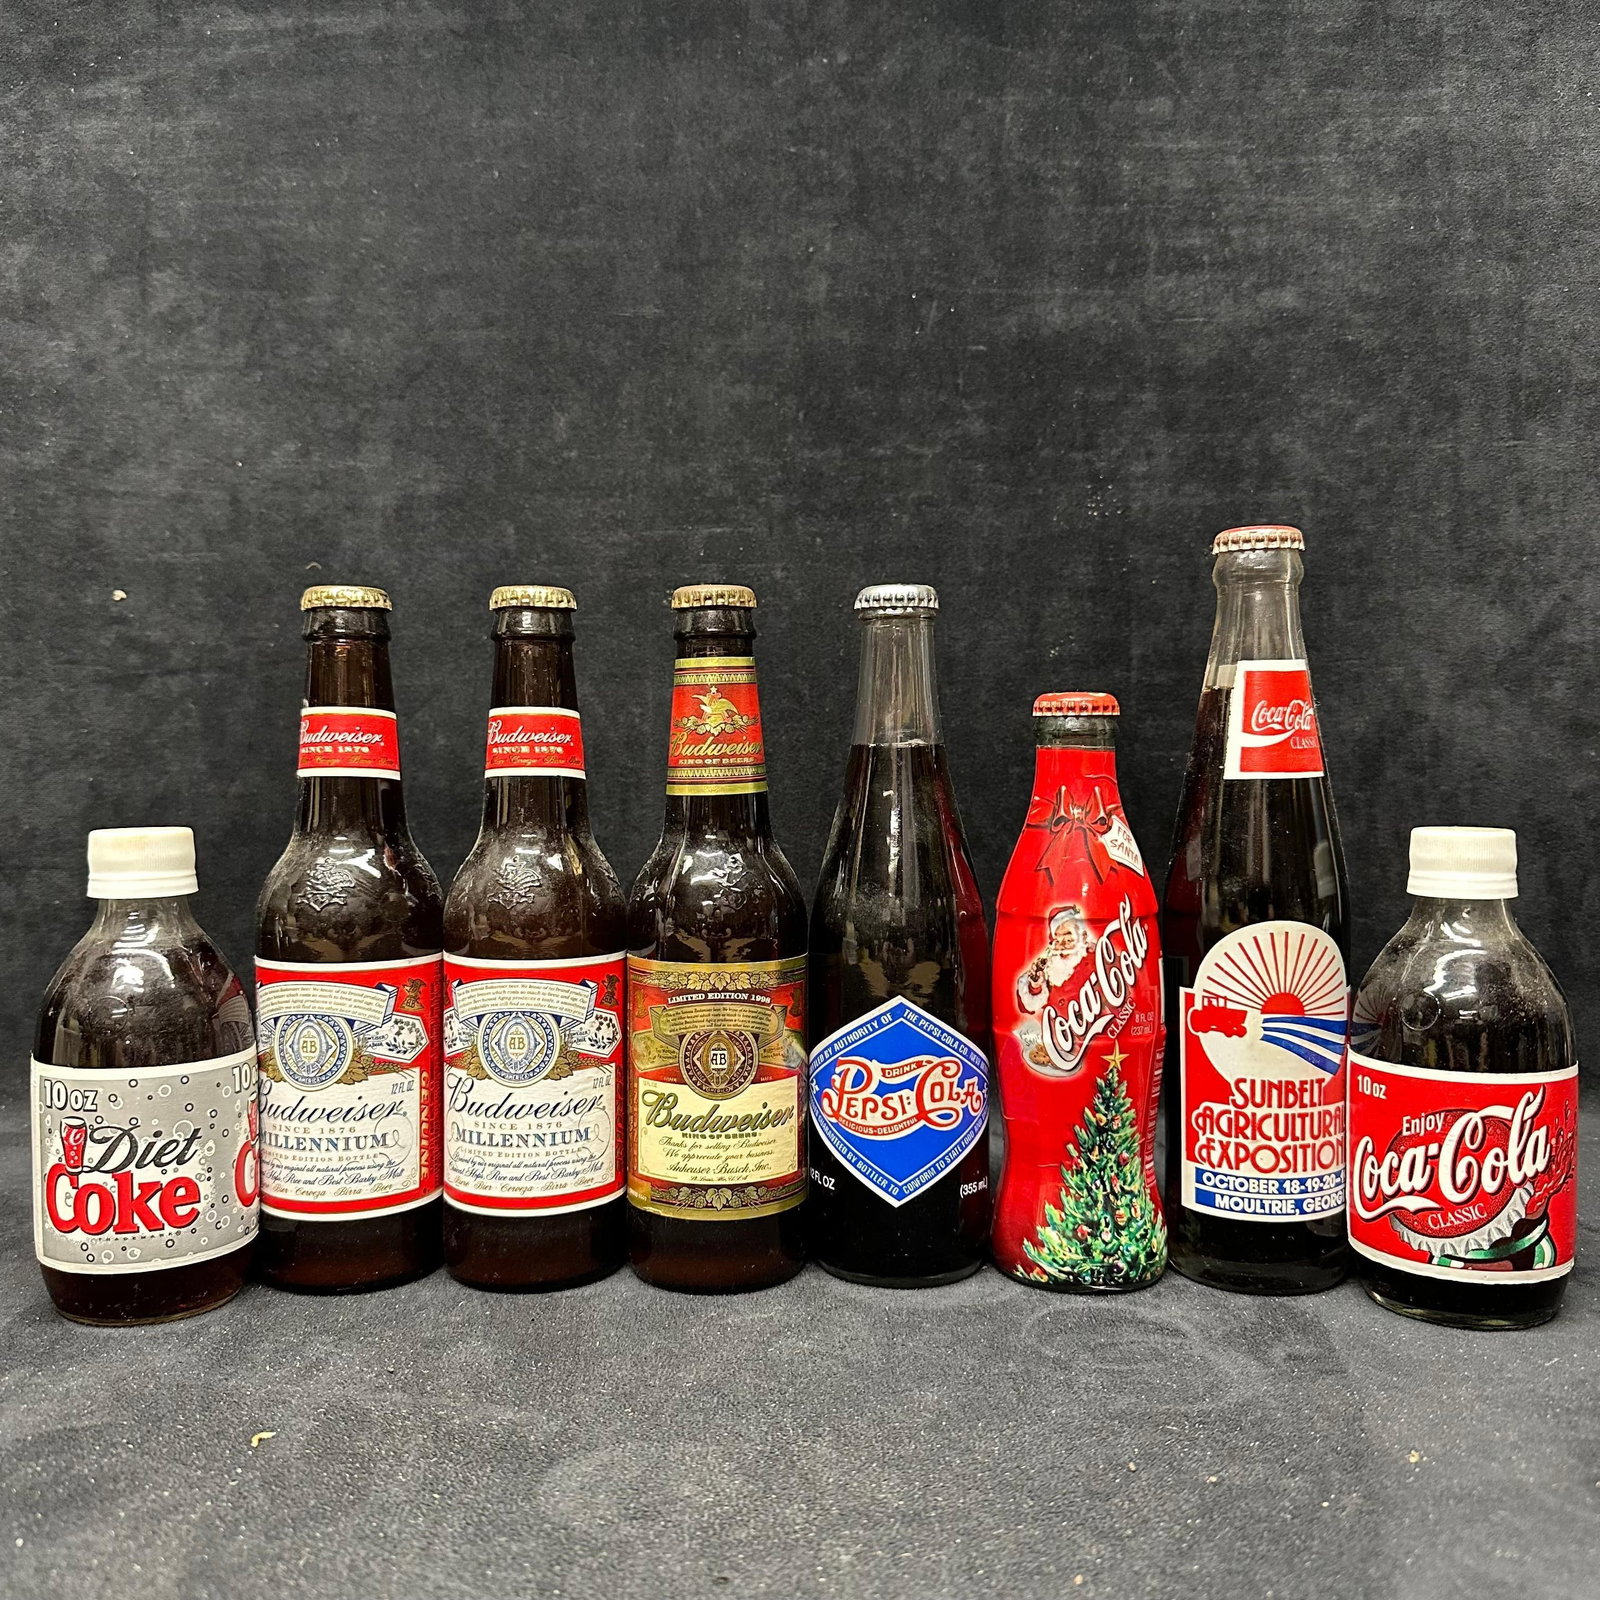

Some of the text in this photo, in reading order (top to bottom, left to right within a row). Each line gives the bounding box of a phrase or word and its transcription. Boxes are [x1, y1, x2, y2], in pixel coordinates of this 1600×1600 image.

[487, 719, 571, 745] Budweiser
[670, 732, 761, 757] Budweiser
[492, 746, 530, 754] SINCE
[1110, 839, 1139, 863] SANTA
[1041, 893, 1148, 1071] Coca-Cola
[667, 992, 771, 1004] LIMITED EDITION 1998
[903, 1009, 918, 1022] THE
[919, 1016, 960, 1049] PEPSI-COLA
[1107, 997, 1136, 1039] CLASSIC
[824, 1047, 832, 1058] BY
[834, 1020, 878, 1051] AUTHORITY
[881, 1012, 893, 1025] OF
[232, 1063, 250, 1094] 10
[885, 1063, 918, 1078] DRINK
[44, 1079, 68, 1111] 10
[391, 1083, 398, 1095] 12
[447, 1074, 604, 1120] Budweiser
[1231, 1077, 1326, 1110] SUNBELT
[1357, 1074, 1371, 1095] 10
[641, 1090, 795, 1133] Budweiser
[272, 1124, 356, 1134] SINCE 1876
[421, 1070, 430, 1180] GENUINE
[452, 1124, 592, 1148] MILLENNIUM
[474, 1121, 562, 1130] SINCE 1876
[1402, 1112, 1445, 1137] Enjoy
[82, 1124, 202, 1174] Diet
[260, 1132, 389, 1151] MILLENNIUM
[546, 1147, 582, 1156] BOTTLE
[659, 1136, 687, 1148] Thanks
[688, 1141, 702, 1151] for
[705, 1142, 731, 1152] selling
[1353, 1084, 1552, 1221] Coca-Cola
[338, 1153, 378, 1162] BOTTLE
[681, 1153, 722, 1162] appreciate
[902, 1168, 936, 1194] CONFORM
[936, 1161, 946, 1173] TO
[945, 1145, 962, 1164] STATE
[961, 1131, 975, 1148] FOOD
[1197, 1137, 1345, 1174] EXPOSITION
[822, 1175, 835, 1190] OZ
[846, 1151, 856, 1164] BY
[857, 1160, 888, 1188] BOTTLER
[888, 1182, 899, 1195] TO
[1202, 1172, 1279, 1194] OCTOBER
[46, 1163, 201, 1235] Coke
[960, 1181, 977, 1199] (355
[1214, 1188, 1345, 1215] MOULTRIE, GEORGI
[1428, 1203, 1487, 1229] CLASSIC
